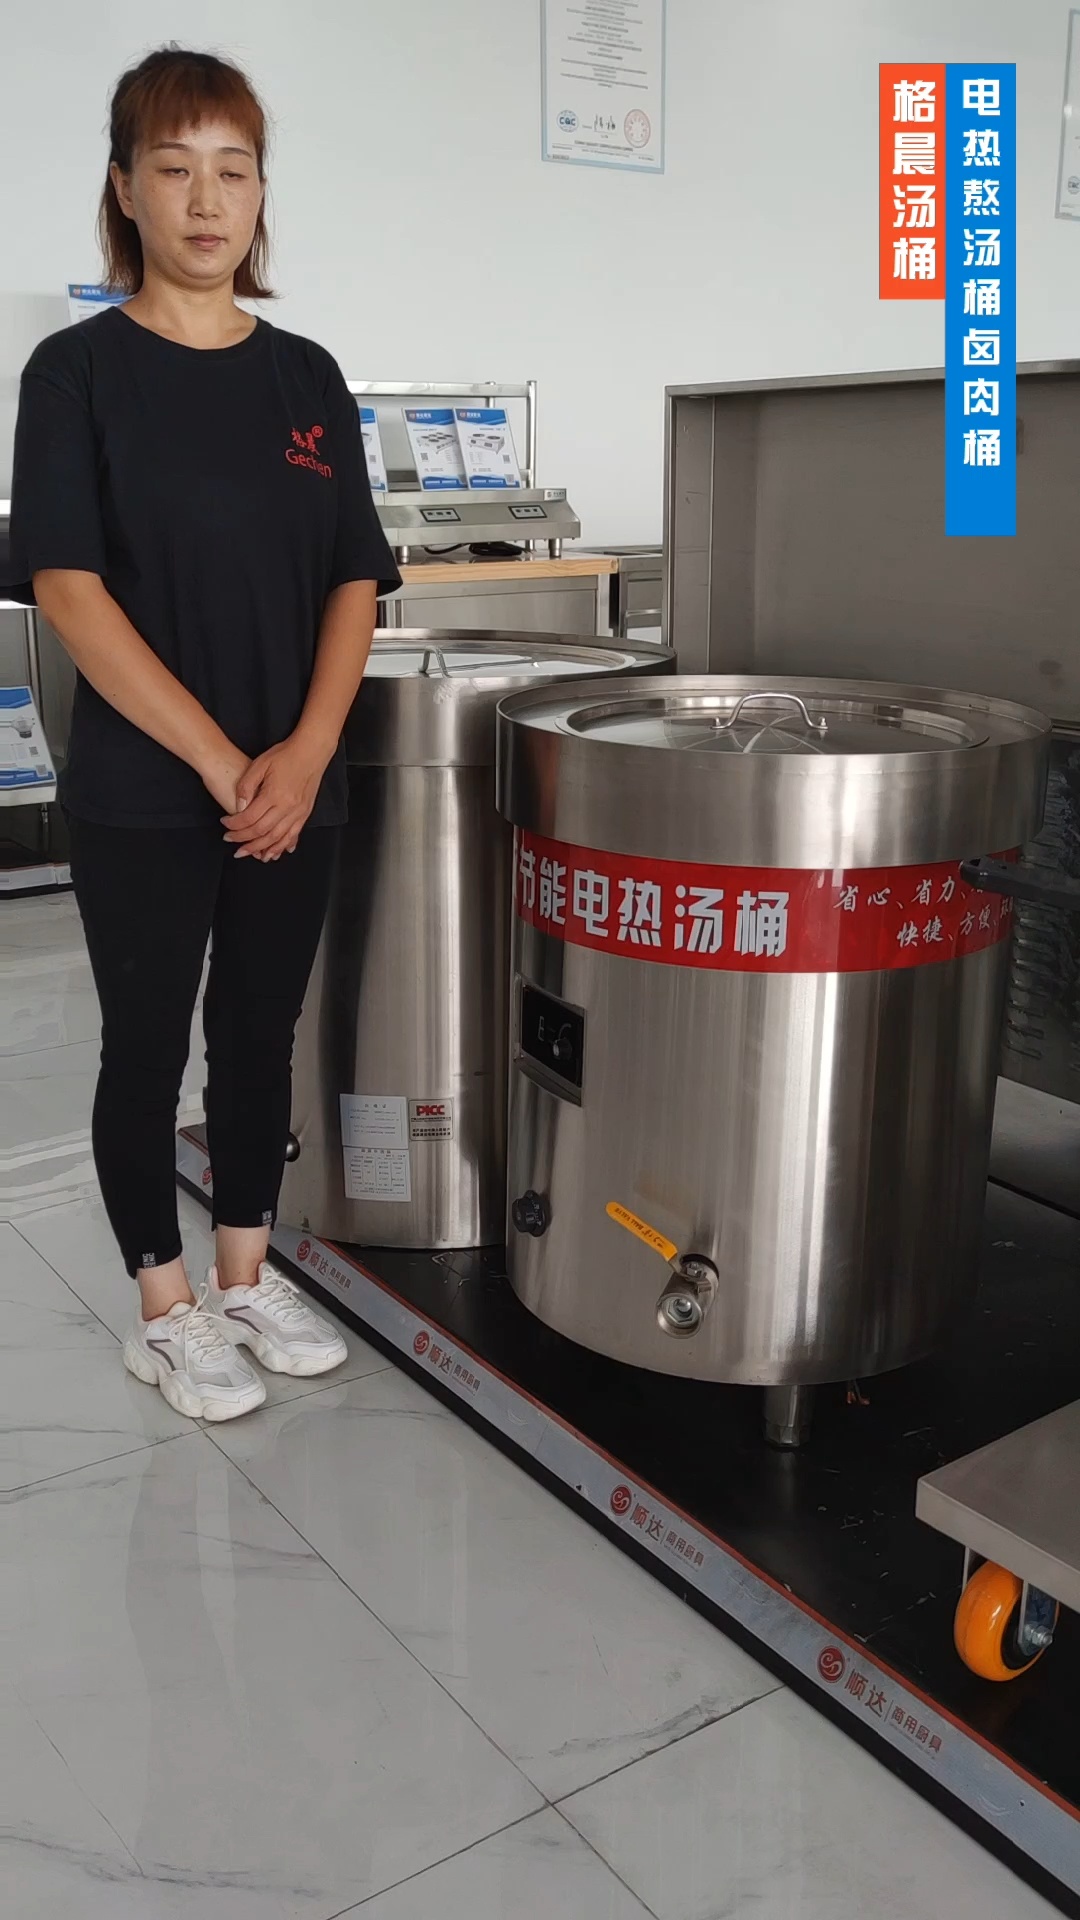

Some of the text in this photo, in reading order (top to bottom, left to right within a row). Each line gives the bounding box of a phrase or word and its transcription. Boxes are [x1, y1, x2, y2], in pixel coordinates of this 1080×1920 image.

[519, 849, 790, 957] 节能电热汤桶
[416, 1105, 445, 1116] PICC
[307, 1251, 328, 1276] 顺达
[427, 1344, 452, 1374] 顺达
[629, 1503, 663, 1541] 顺达
[666, 1531, 704, 1566] 商用厨具
[844, 1668, 887, 1718] 顺达
[891, 1706, 942, 1753] 商用厨具
